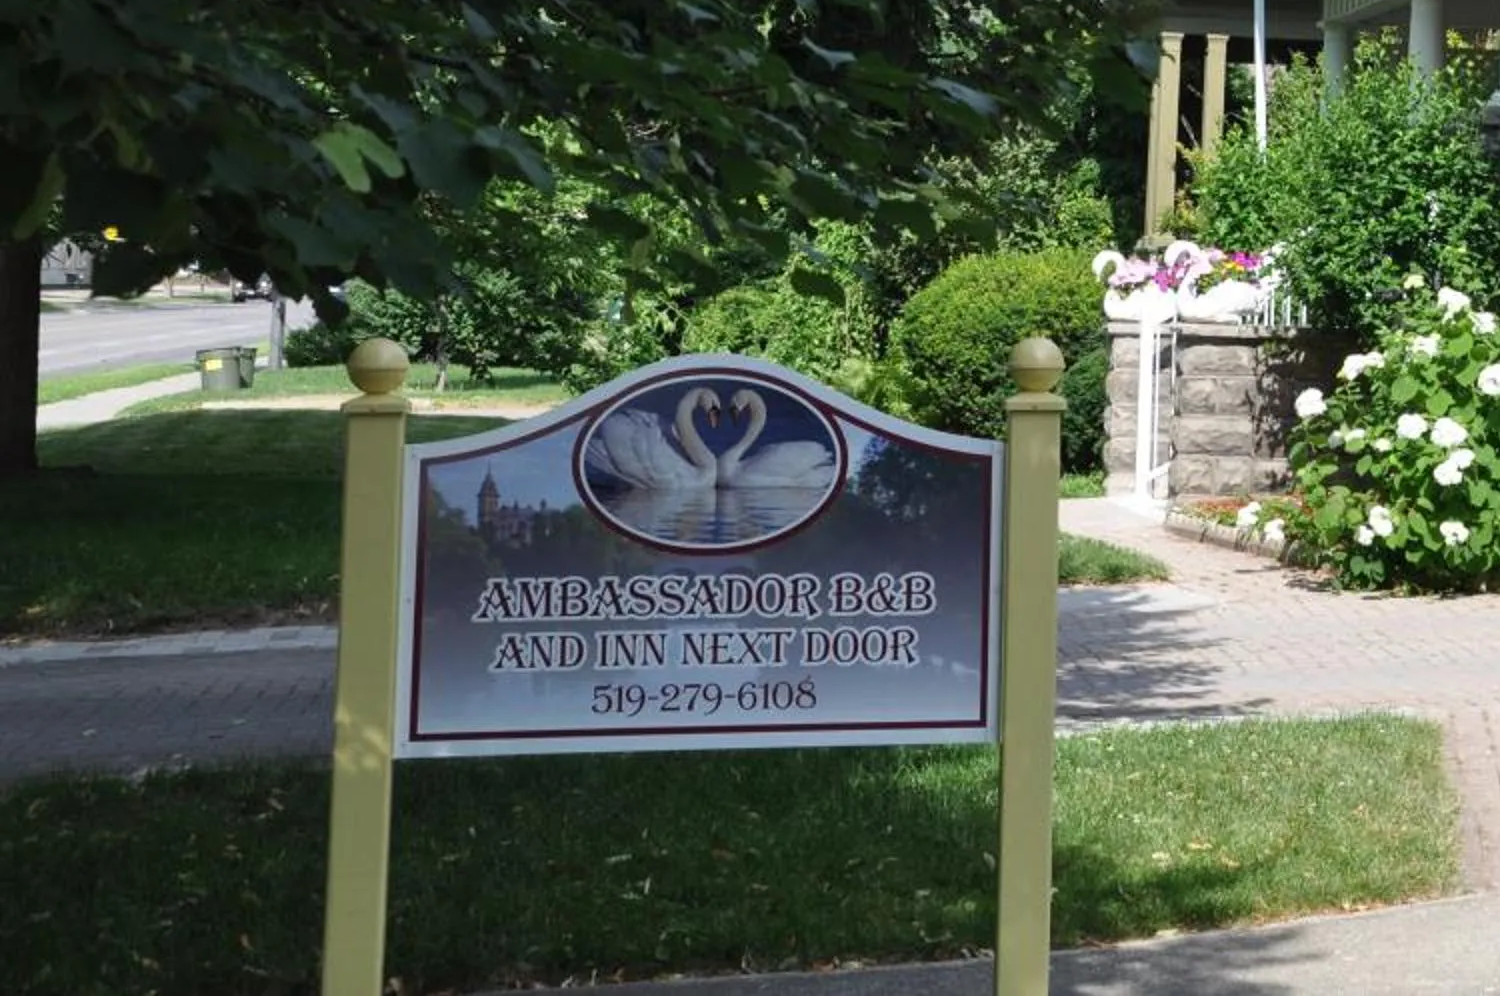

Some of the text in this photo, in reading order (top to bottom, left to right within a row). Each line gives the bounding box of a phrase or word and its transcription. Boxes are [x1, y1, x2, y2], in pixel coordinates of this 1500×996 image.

[473, 573, 936, 621] AMBASSADOR B&B
[490, 627, 921, 672] AND INN NEXT DOOR
[591, 680, 817, 717] 519-279-6108
